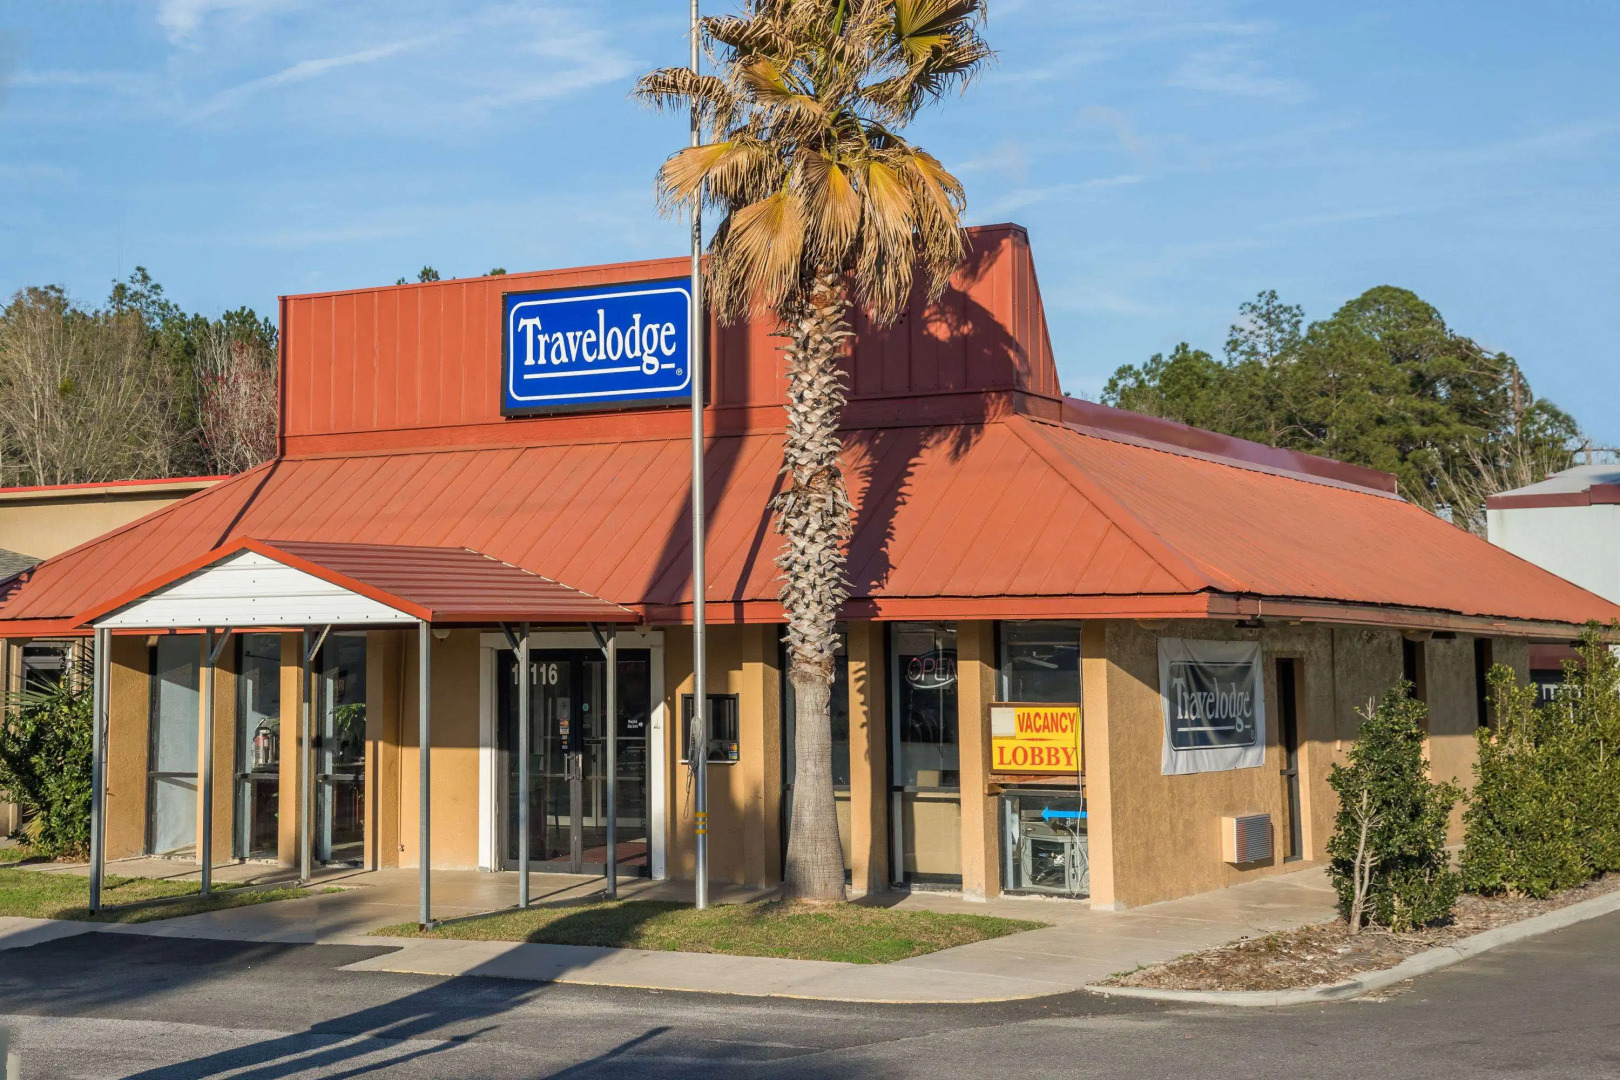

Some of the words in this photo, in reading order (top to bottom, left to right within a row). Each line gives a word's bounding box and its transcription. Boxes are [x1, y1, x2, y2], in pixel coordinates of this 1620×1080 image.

[517, 309, 676, 375] Travelodge
[512, 663, 557, 685] 1116
[908, 657, 957, 680] OPEN
[1172, 676, 1251, 732] Travelodge
[1017, 712, 1076, 733] VACANCY
[997, 745, 1076, 766] LOBBY
